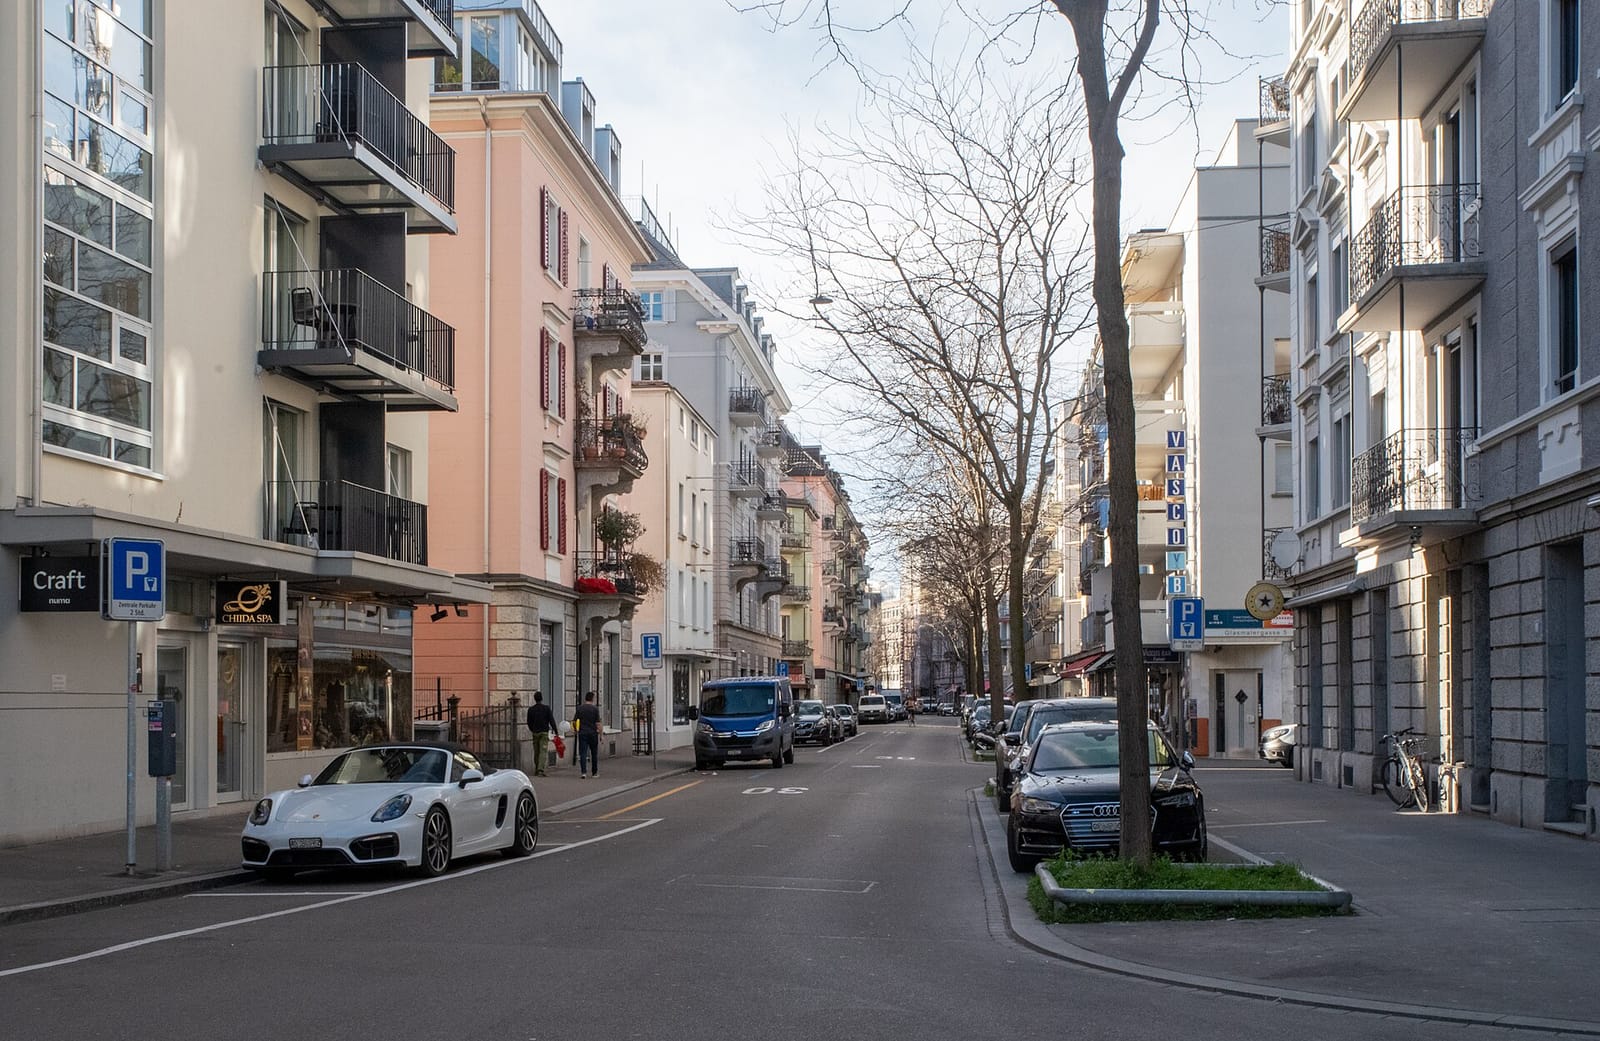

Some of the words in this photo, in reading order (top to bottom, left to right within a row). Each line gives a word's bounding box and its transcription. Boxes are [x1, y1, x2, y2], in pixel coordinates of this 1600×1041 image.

[1171, 431, 1181, 545] VASCO
[33, 569, 86, 590] Craft
[126, 551, 149, 589] P
[256, 614, 273, 623] SPA
[1182, 602, 1195, 621] P
[647, 637, 656, 650] P
